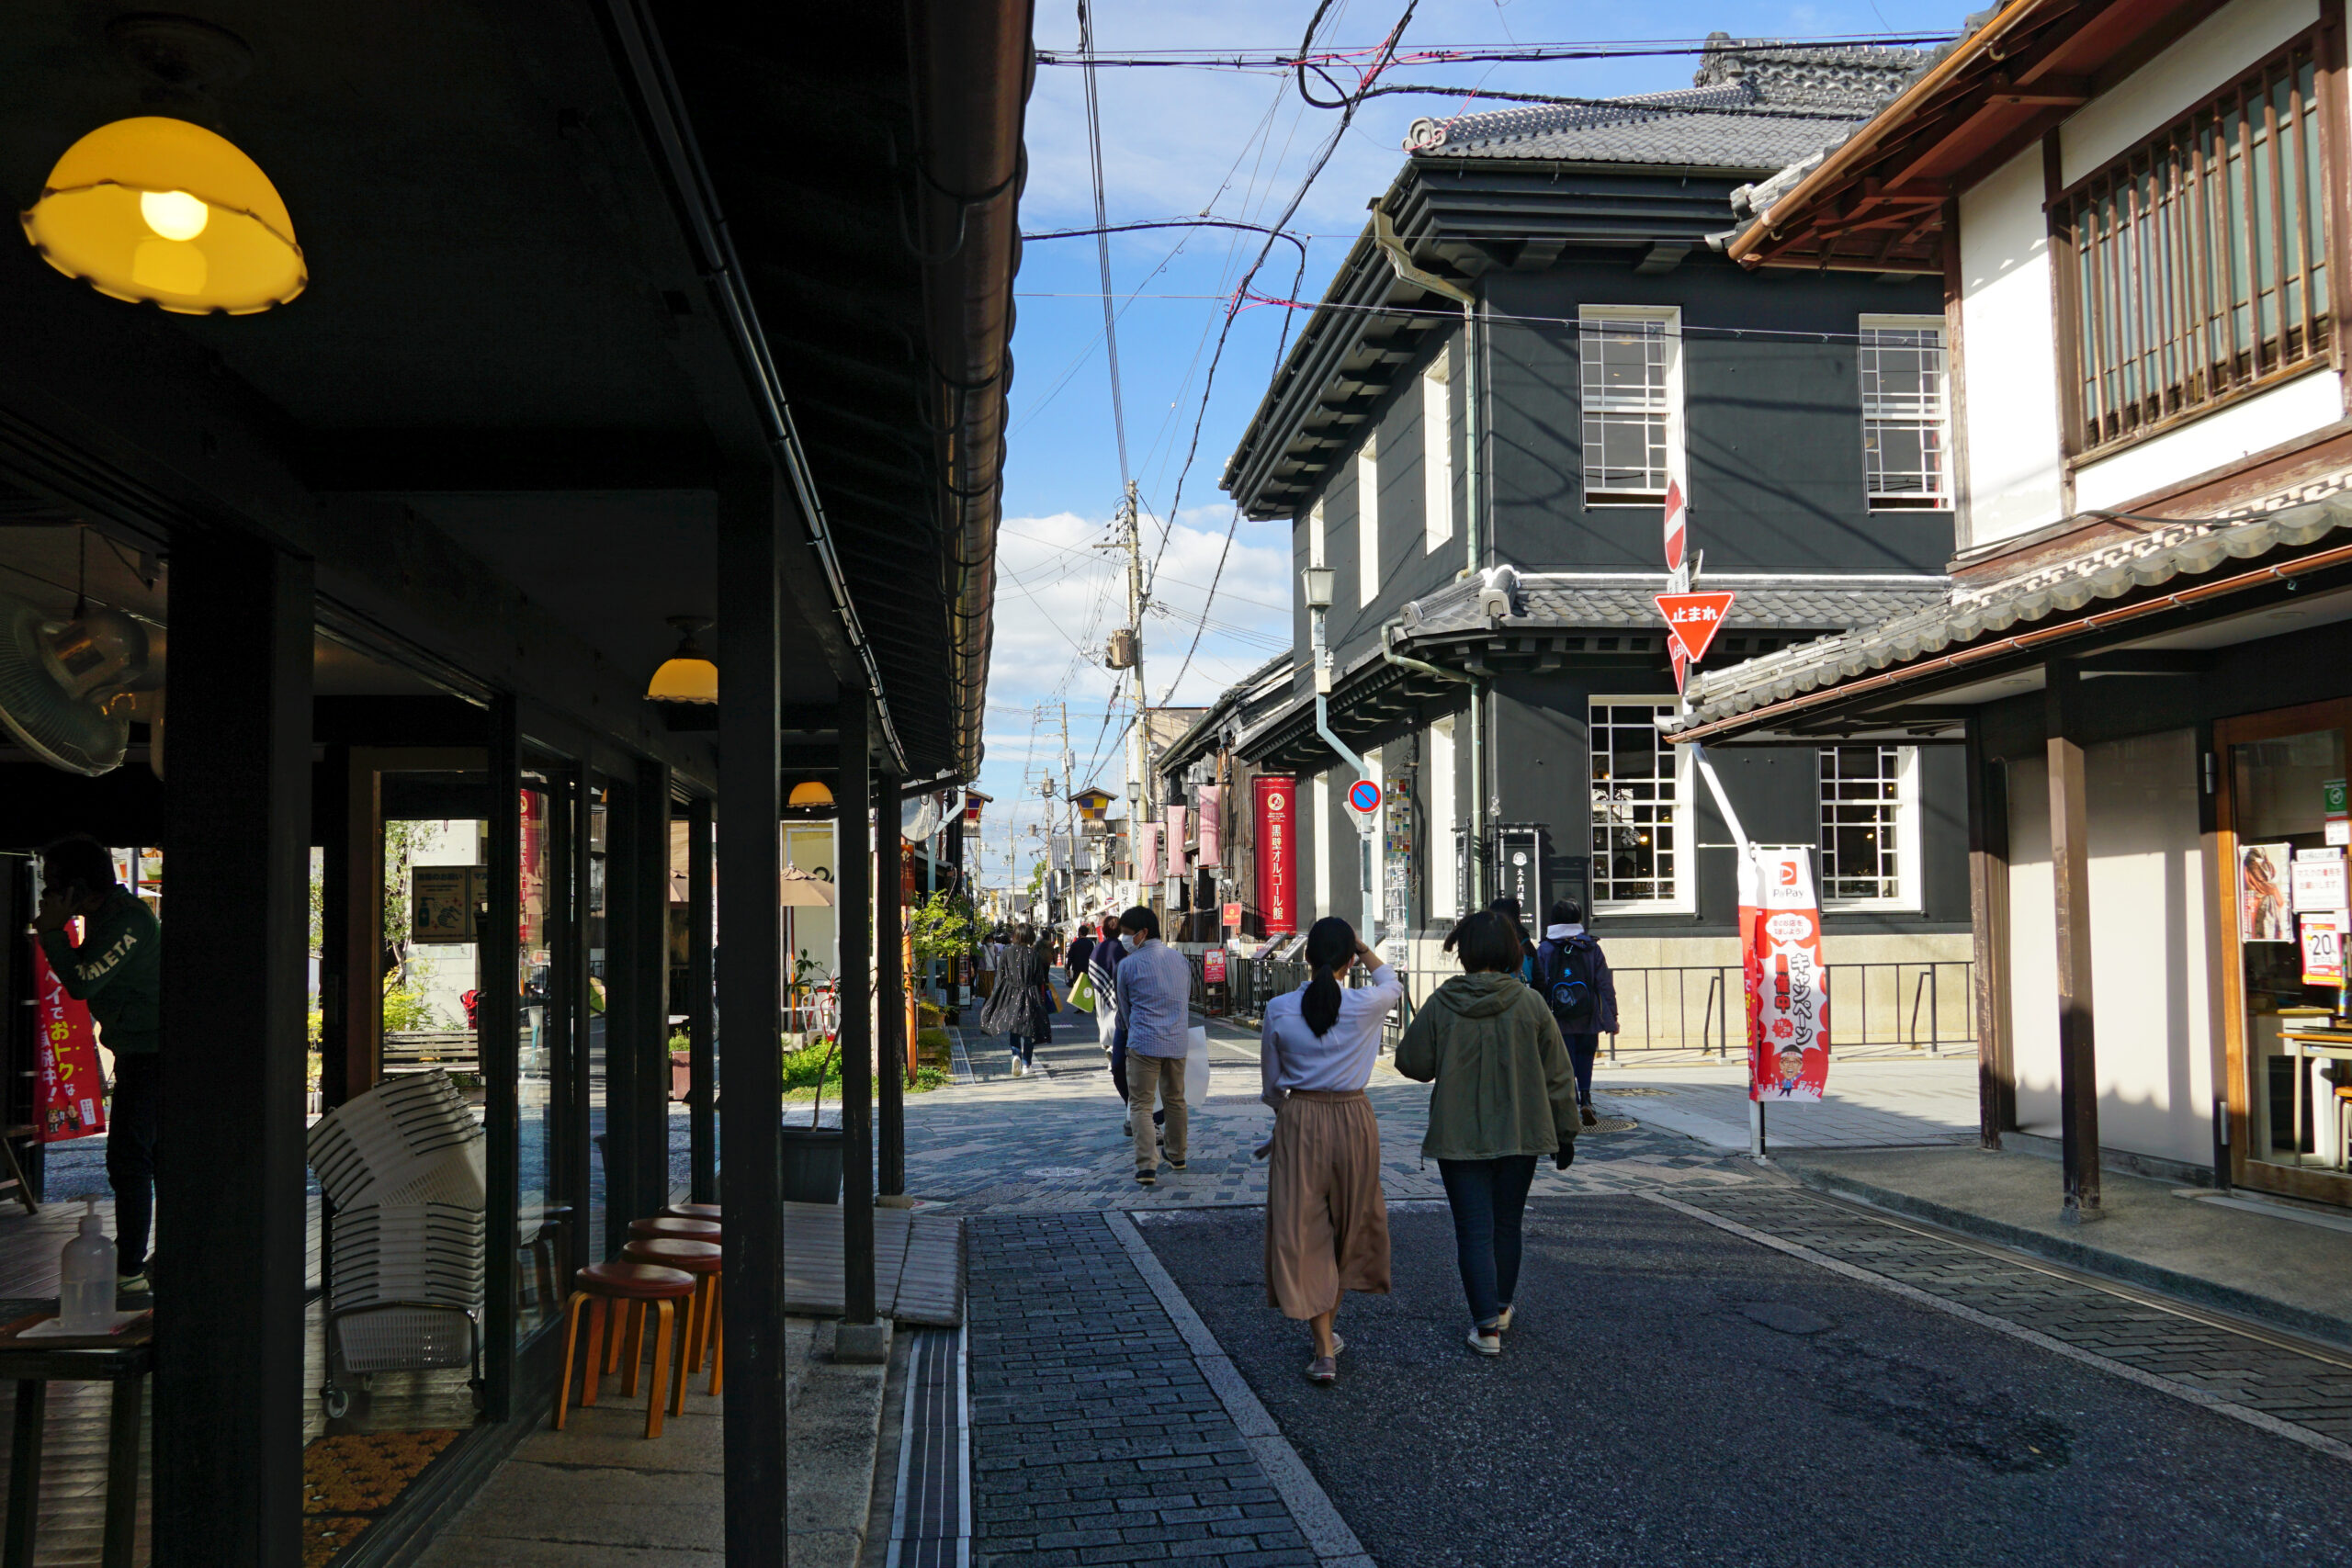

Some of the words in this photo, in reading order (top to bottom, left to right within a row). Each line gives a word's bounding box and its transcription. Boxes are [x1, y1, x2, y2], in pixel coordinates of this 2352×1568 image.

[1671, 606, 1718, 623] 止まれ
[1272, 824, 1283, 919] 黒壁オルゴール館
[1517, 868, 1525, 908] 大手門通り
[1791, 953, 1813, 1045] キャンペーン
